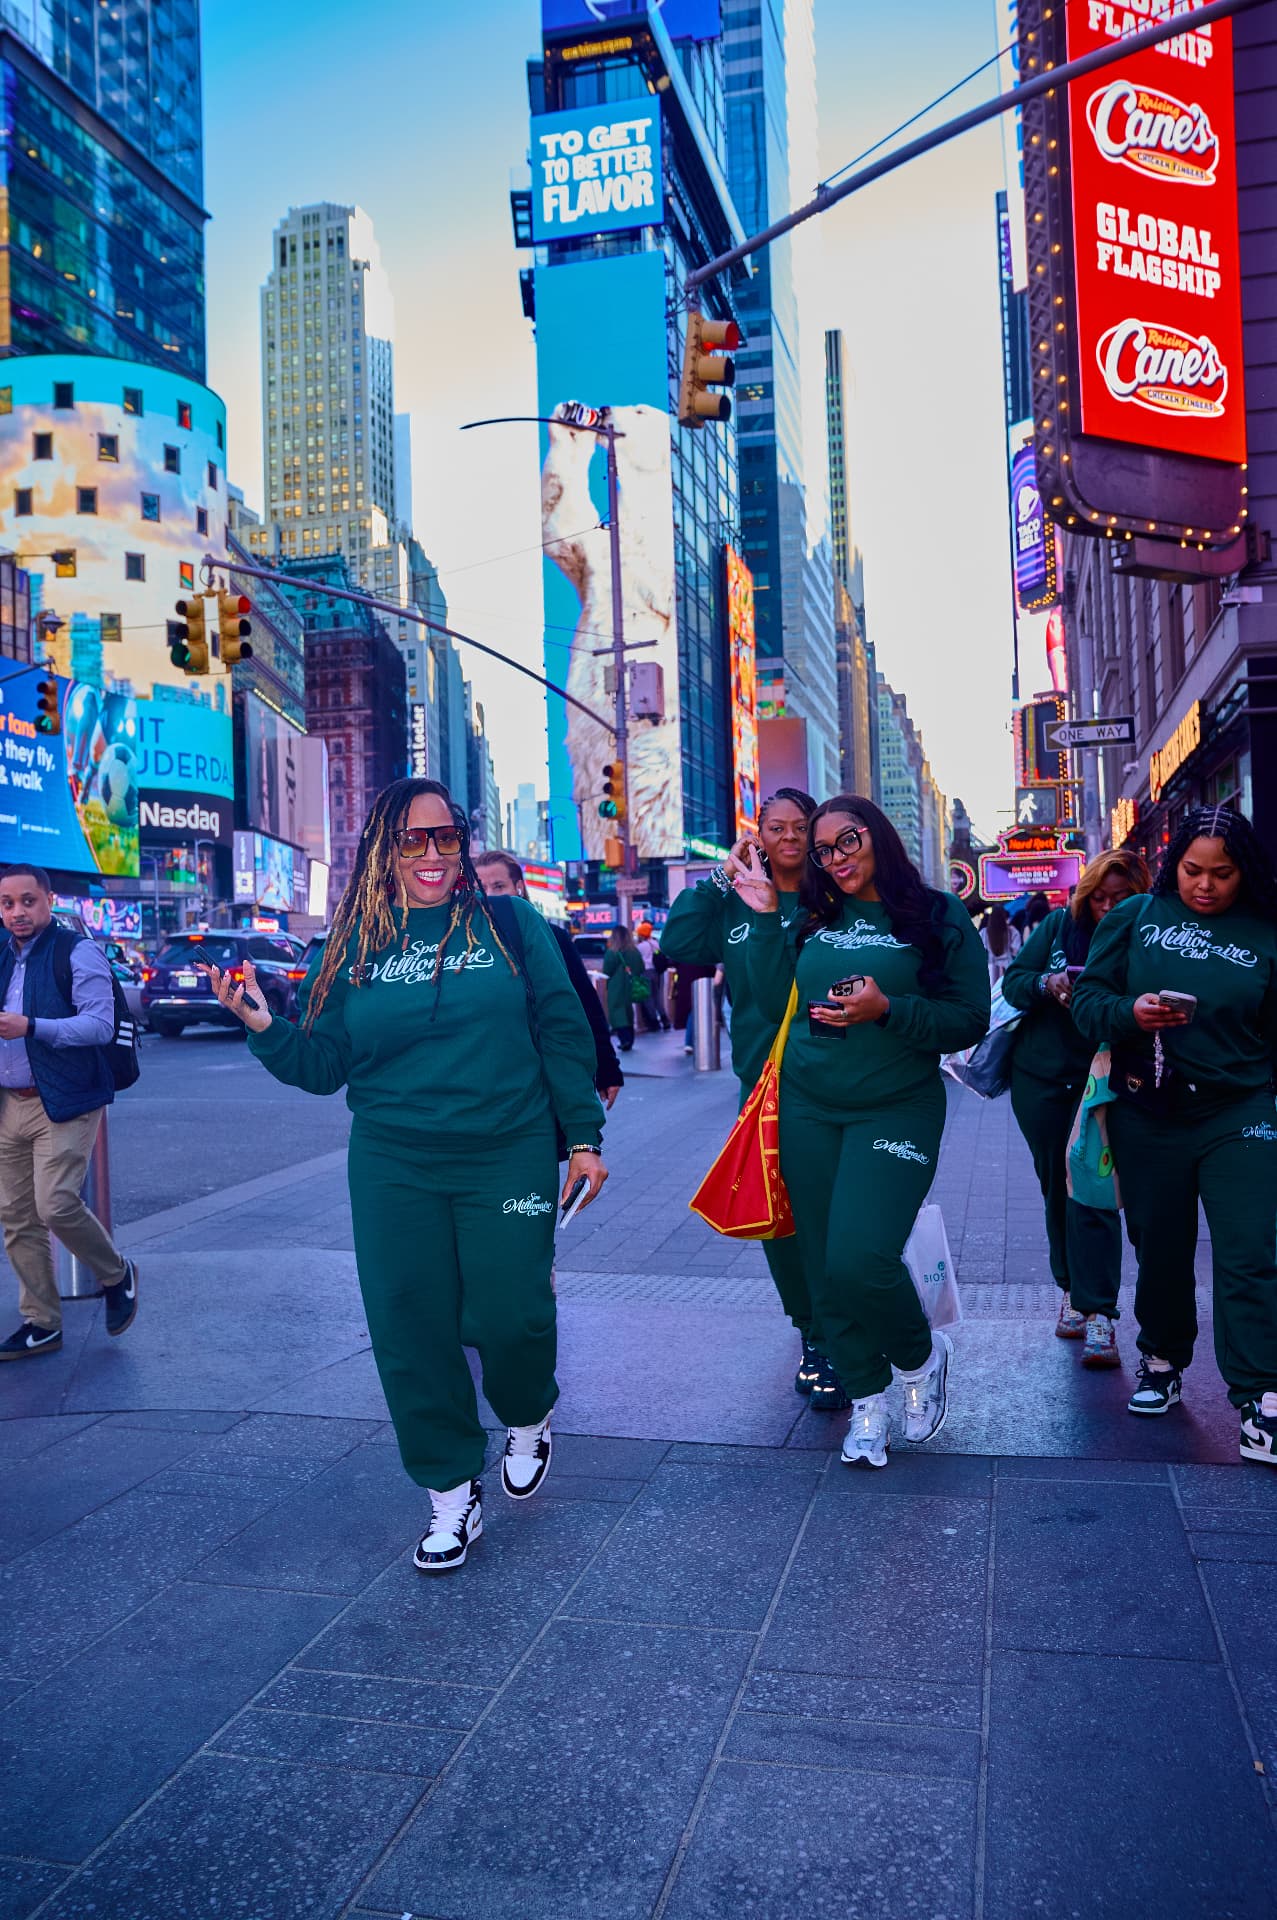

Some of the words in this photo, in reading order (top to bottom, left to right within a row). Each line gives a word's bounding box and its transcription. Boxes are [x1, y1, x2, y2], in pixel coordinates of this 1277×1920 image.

[1095, 81, 1215, 157] Cane's
[1137, 92, 1181, 120] Raising
[540, 131, 583, 158] TO
[588, 118, 652, 151] GET
[541, 158, 569, 185] TO
[572, 145, 652, 180] BETTER
[542, 171, 655, 223] FLAVOR
[1096, 202, 1219, 269] GLOBAL
[1096, 240, 1221, 299] FLAGSHIP
[1147, 328, 1190, 353] Raising
[1105, 319, 1224, 397] Cane's
[1017, 517, 1041, 536] TACO
[8, 711, 37, 739] fans
[412, 705, 426, 750] Locker
[1058, 728, 1084, 742] ONE
[1096, 725, 1124, 739] WAY
[5, 737, 35, 768] they
[37, 744, 56, 772] fly,
[11, 770, 43, 792] walk
[140, 802, 220, 838] Nasdaq
[1008, 838, 1033, 851] Hard
[1033, 837, 1056, 851] Rock
[584, 911, 612, 924] OLICE
[403, 940, 440, 957] Spa
[1139, 924, 1258, 967] Millionaire
[1180, 948, 1209, 960] Club
[404, 970, 437, 984] Clu
